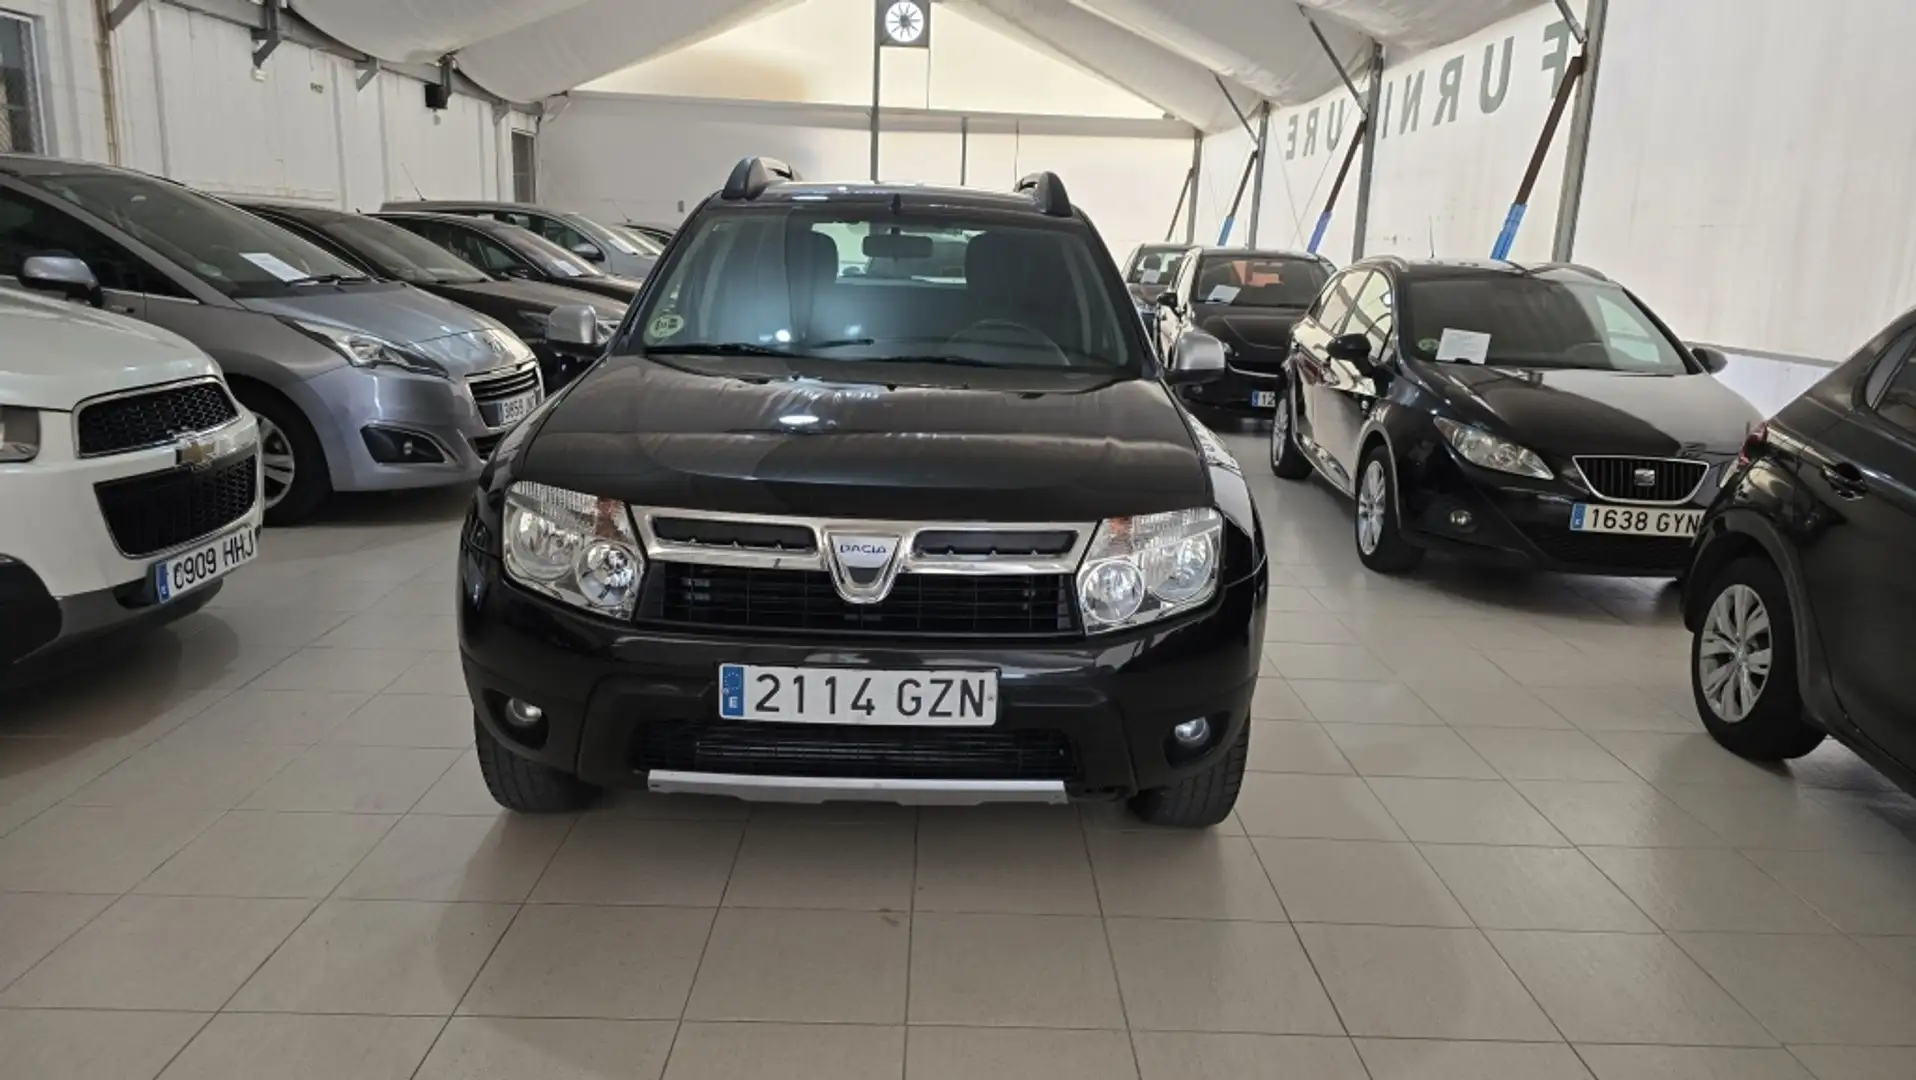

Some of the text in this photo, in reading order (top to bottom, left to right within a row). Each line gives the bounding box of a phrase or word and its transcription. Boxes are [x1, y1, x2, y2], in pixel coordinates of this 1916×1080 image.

[1591, 508, 1701, 535] 1638 GYN
[222, 529, 255, 567] HHJ
[840, 544, 887, 554] DACIA
[755, 673, 986, 718] 2114 GZN
